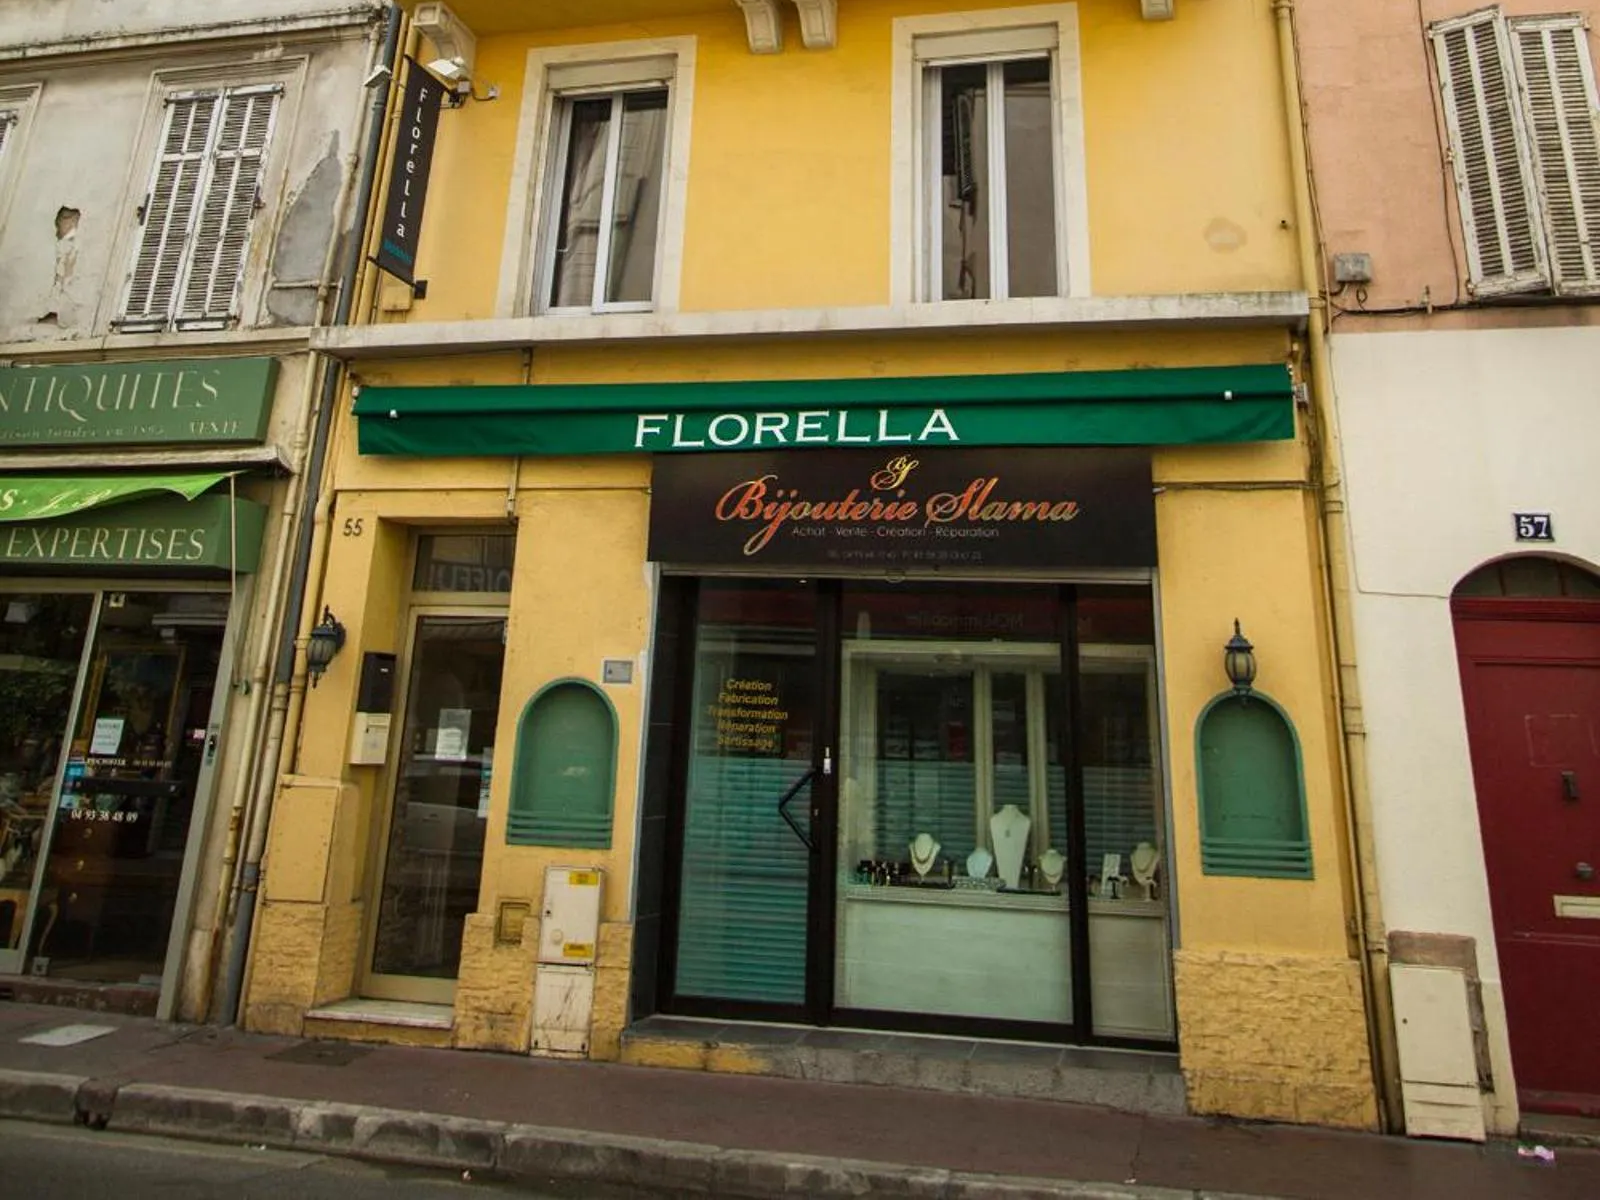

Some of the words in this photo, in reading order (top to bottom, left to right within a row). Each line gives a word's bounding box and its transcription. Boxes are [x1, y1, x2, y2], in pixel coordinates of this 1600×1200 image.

[397, 87, 428, 238] Florella
[634, 409, 960, 448] FLORELLA
[343, 517, 363, 538] 55
[715, 475, 918, 556] Bijouterie
[925, 477, 1079, 528] Slama
[792, 525, 825, 537] Achat
[1519, 516, 1549, 538] 57
[6, 526, 206, 560] EXPERTISES
